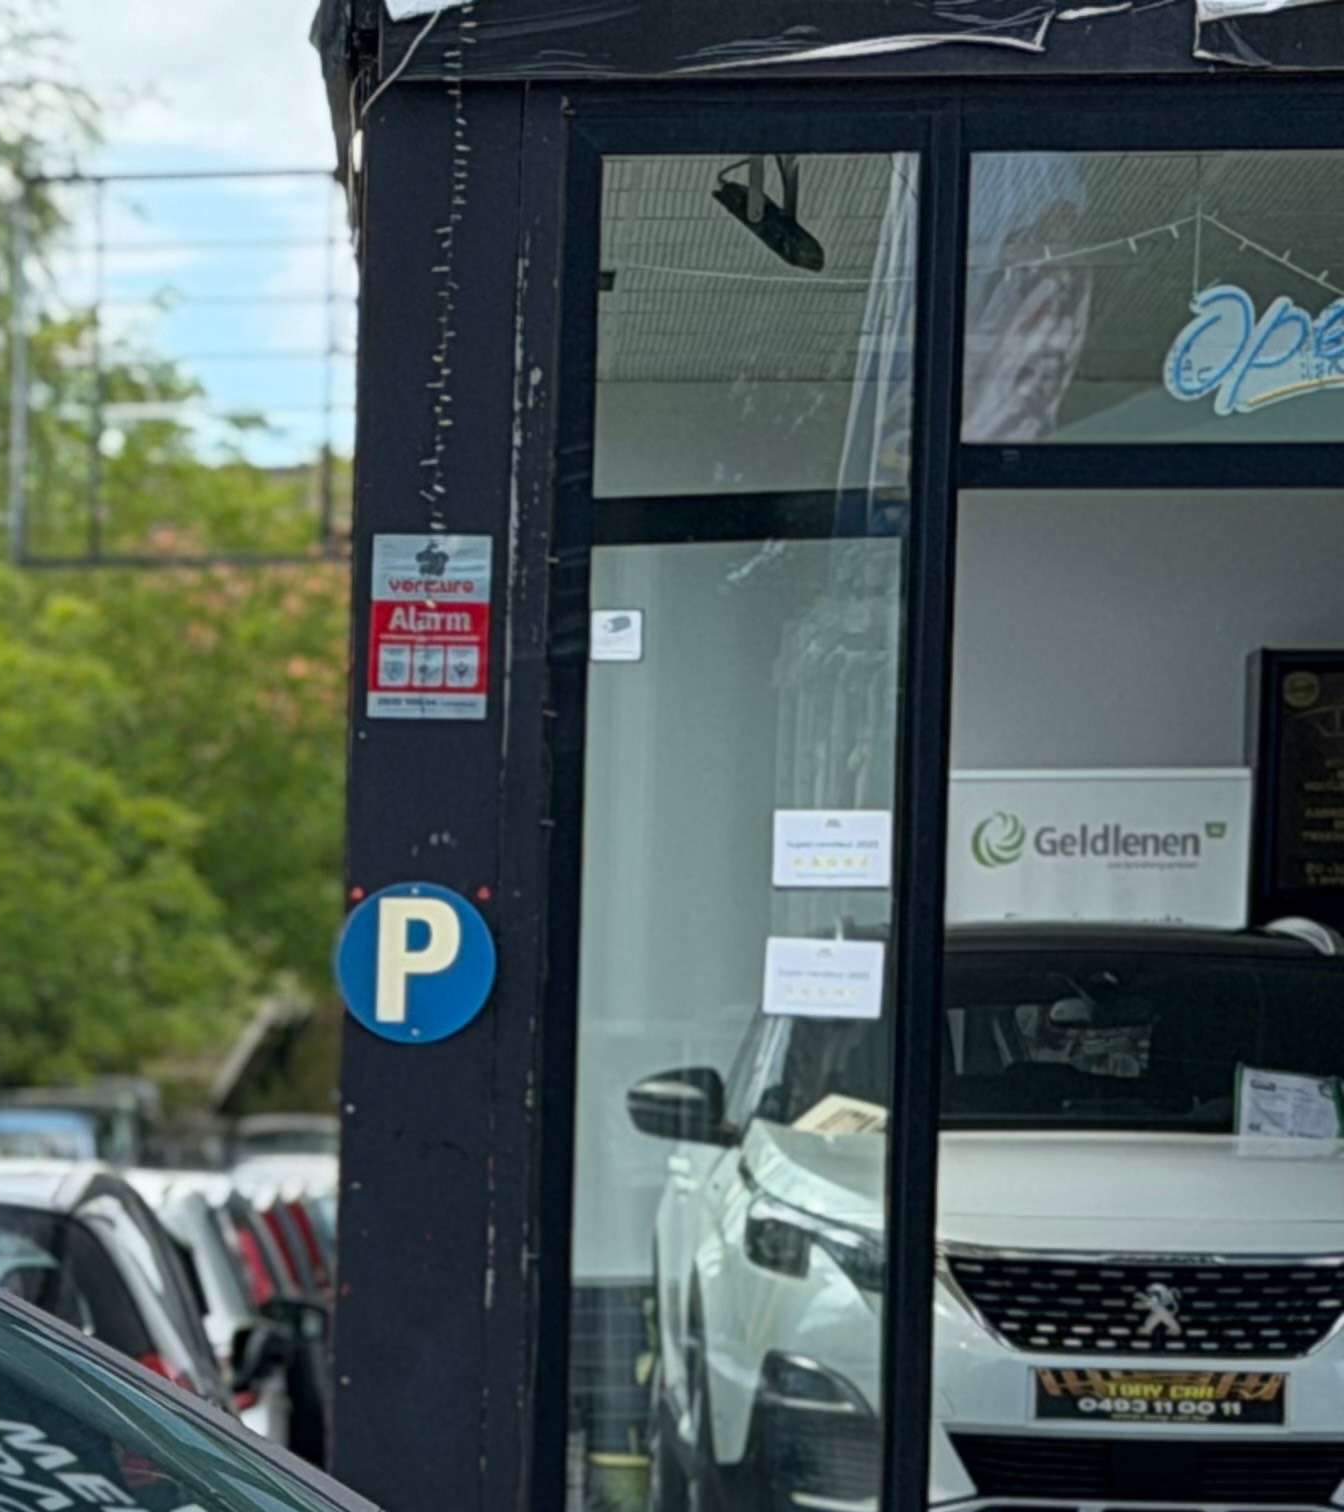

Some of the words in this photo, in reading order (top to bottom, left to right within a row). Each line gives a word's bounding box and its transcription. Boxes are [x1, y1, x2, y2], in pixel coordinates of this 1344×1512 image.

[388, 606, 472, 632] Alarm
[1034, 824, 1201, 857] Geldlenen
[375, 897, 461, 1024] P
[1078, 1397, 1148, 1413] 0493
[1154, 1400, 1174, 1414] 11
[1178, 1400, 1215, 1415] 00
[1220, 1402, 1242, 1416] 11
